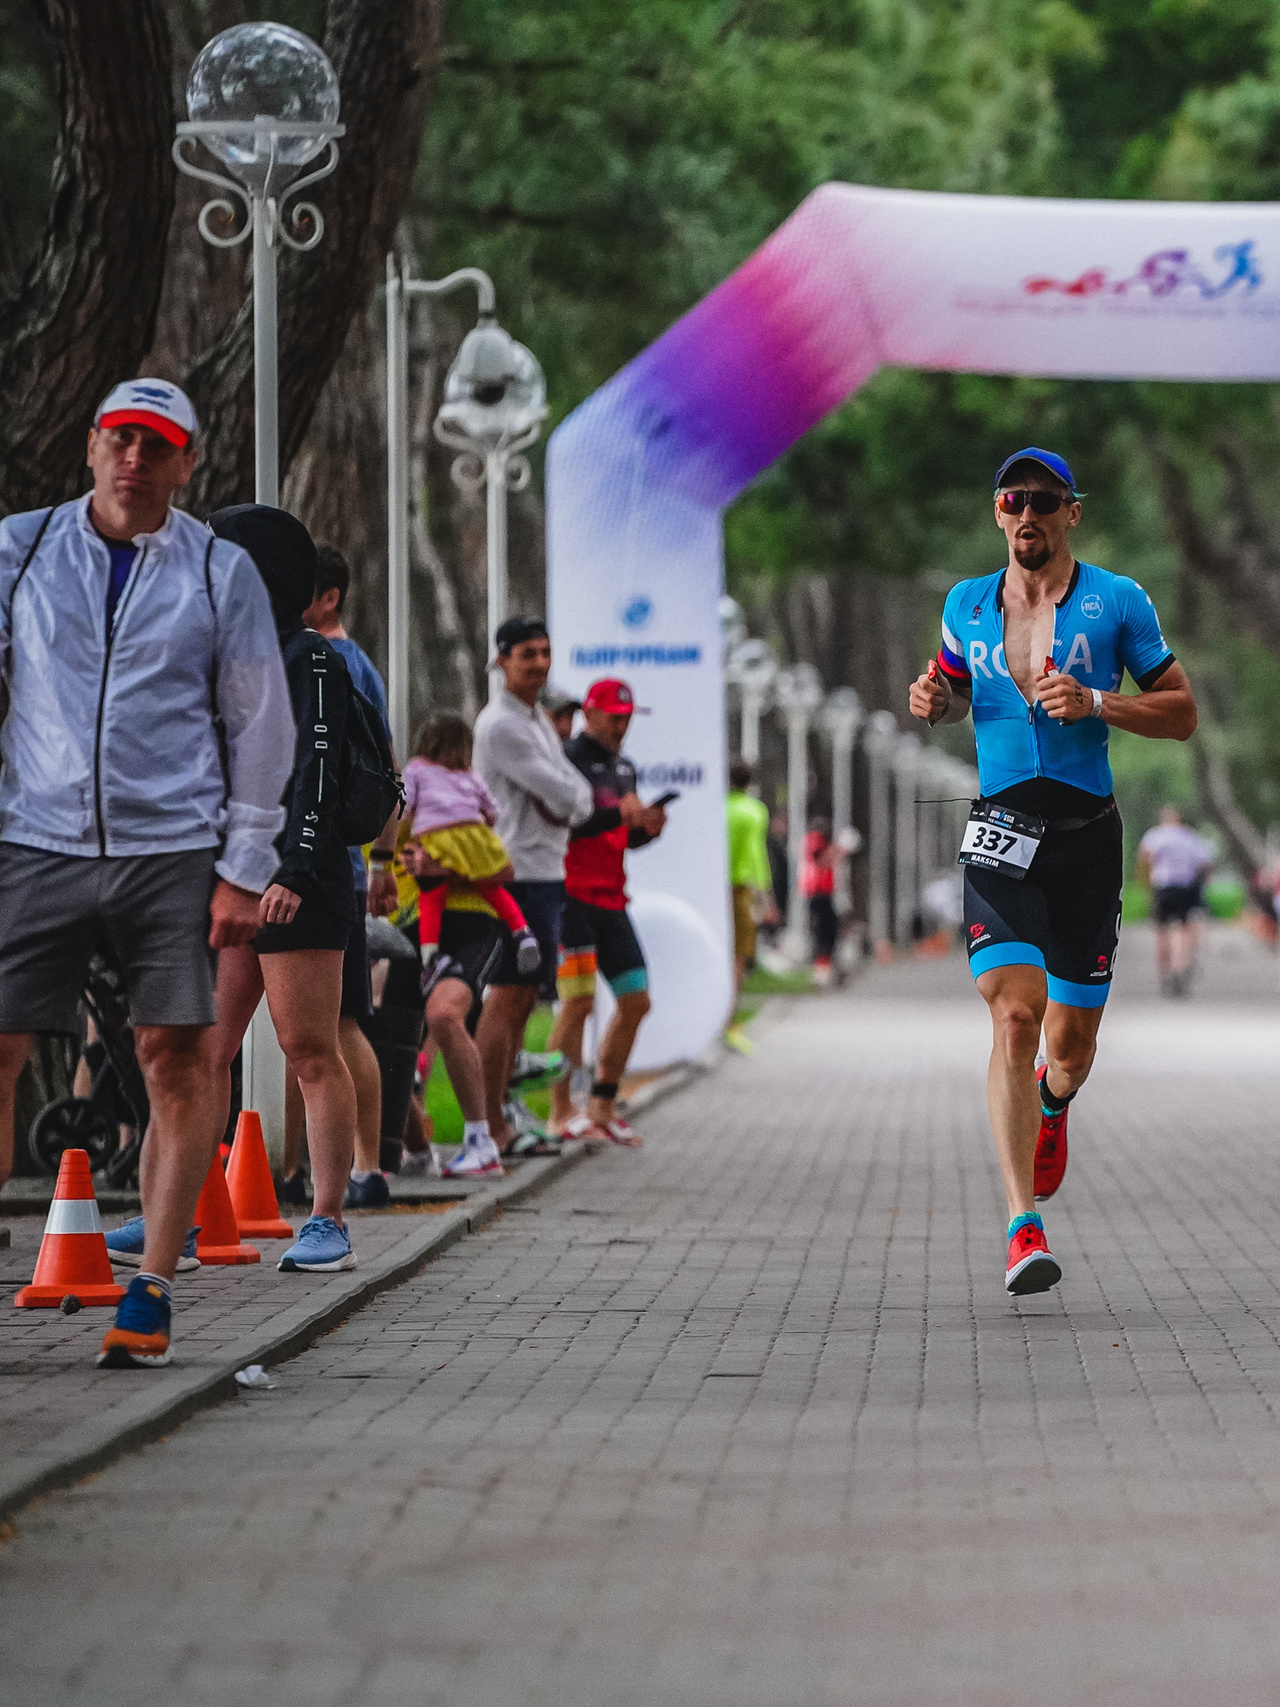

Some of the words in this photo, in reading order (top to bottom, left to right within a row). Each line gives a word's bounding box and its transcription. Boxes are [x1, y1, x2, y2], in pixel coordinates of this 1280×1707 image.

[1084, 602, 1100, 611] RCA
[299, 810, 319, 851] JUS
[313, 724, 329, 749] DO
[972, 826, 1018, 856] 337
[970, 854, 1000, 868] MAKSIM
